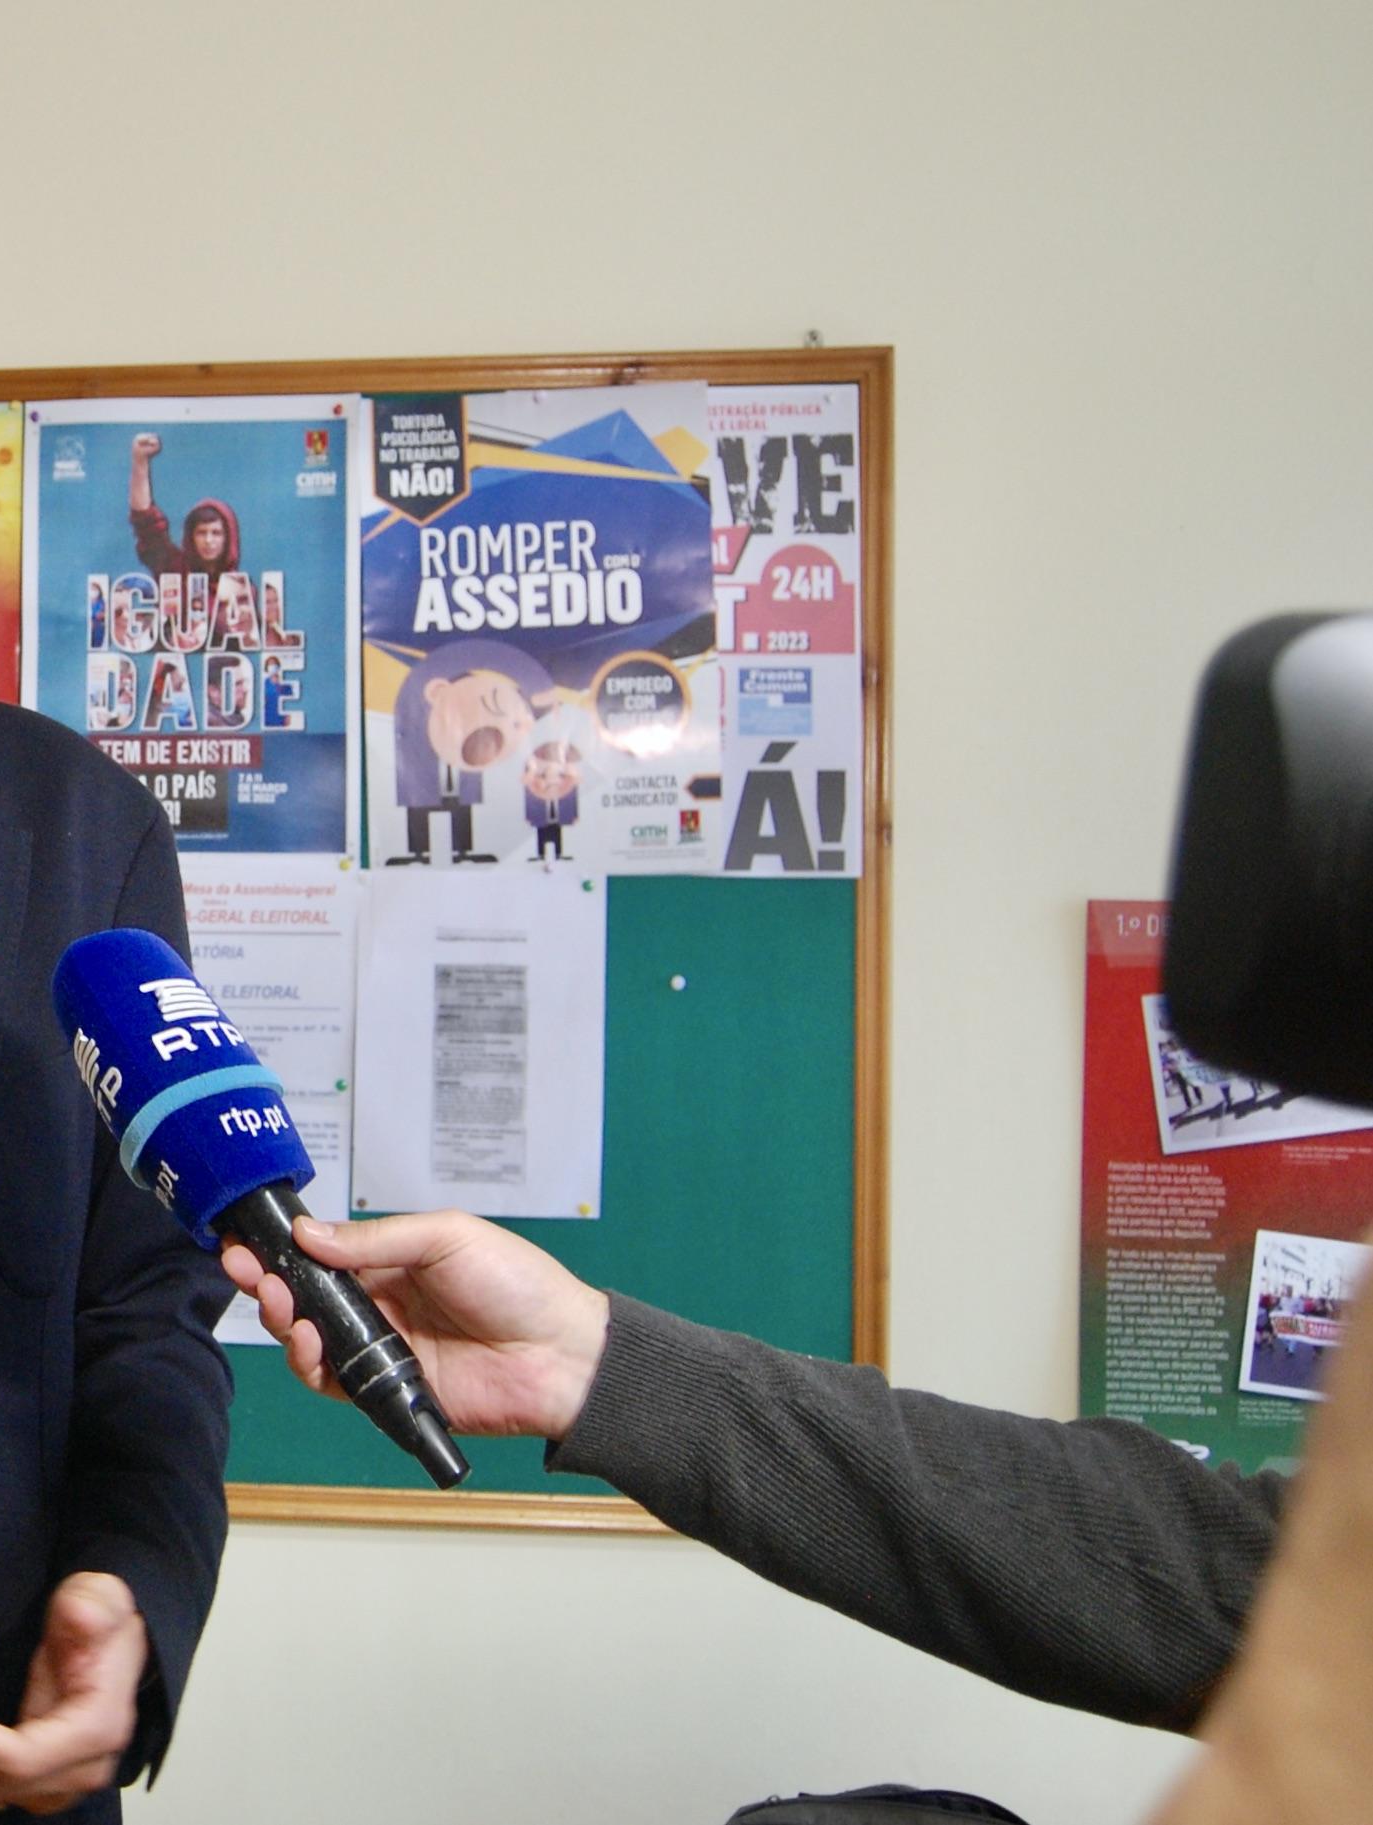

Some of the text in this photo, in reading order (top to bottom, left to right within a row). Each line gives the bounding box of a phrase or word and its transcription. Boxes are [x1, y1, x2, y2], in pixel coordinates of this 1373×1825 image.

[399, 445, 460, 463] TRABALHO
[389, 462, 455, 498] NÃO!
[420, 520, 597, 578] ROMPER
[413, 559, 643, 633] ASSÉDIO
[771, 565, 834, 601] 24H
[87, 571, 305, 653] IGUAL
[767, 630, 811, 651] 2023
[87, 651, 305, 732] DADE
[99, 739, 251, 764] TEM DE EXISTIR
[154, 774, 168, 799] O
[172, 770, 217, 799] PAÍS
[249, 909, 330, 924] ELEITORAL
[191, 943, 244, 959] ATÓRIA
[221, 985, 301, 1000] ELEITORAL
[151, 1021, 245, 1062] RTP
[96, 1066, 123, 1128] TP
[219, 1104, 289, 1138] rtp.pt
